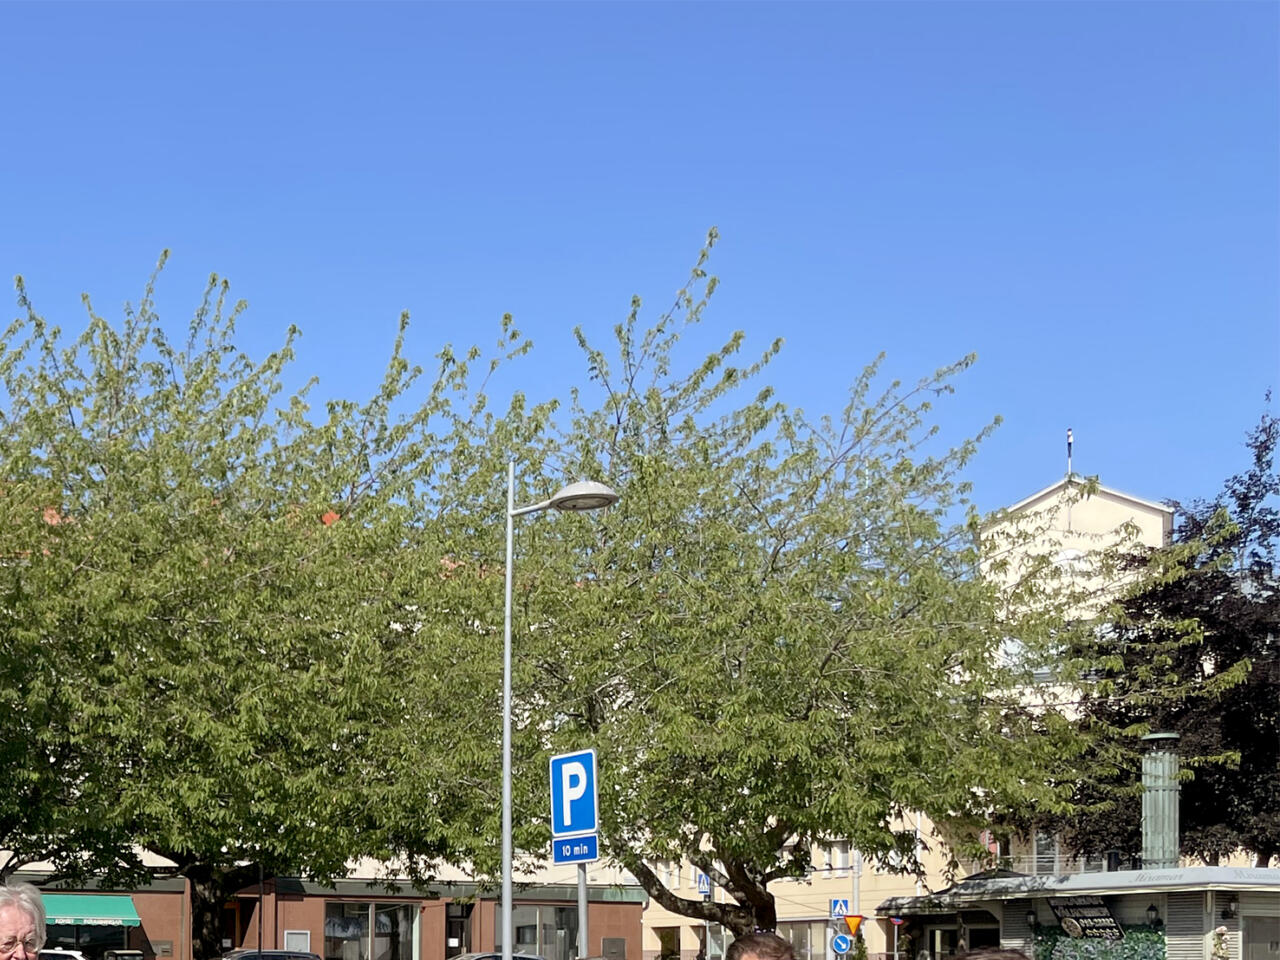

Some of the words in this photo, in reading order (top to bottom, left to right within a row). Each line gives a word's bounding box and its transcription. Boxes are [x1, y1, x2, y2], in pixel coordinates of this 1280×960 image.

[561, 761, 588, 827] P
[562, 845, 571, 857] 10
[573, 843, 589, 856] min
